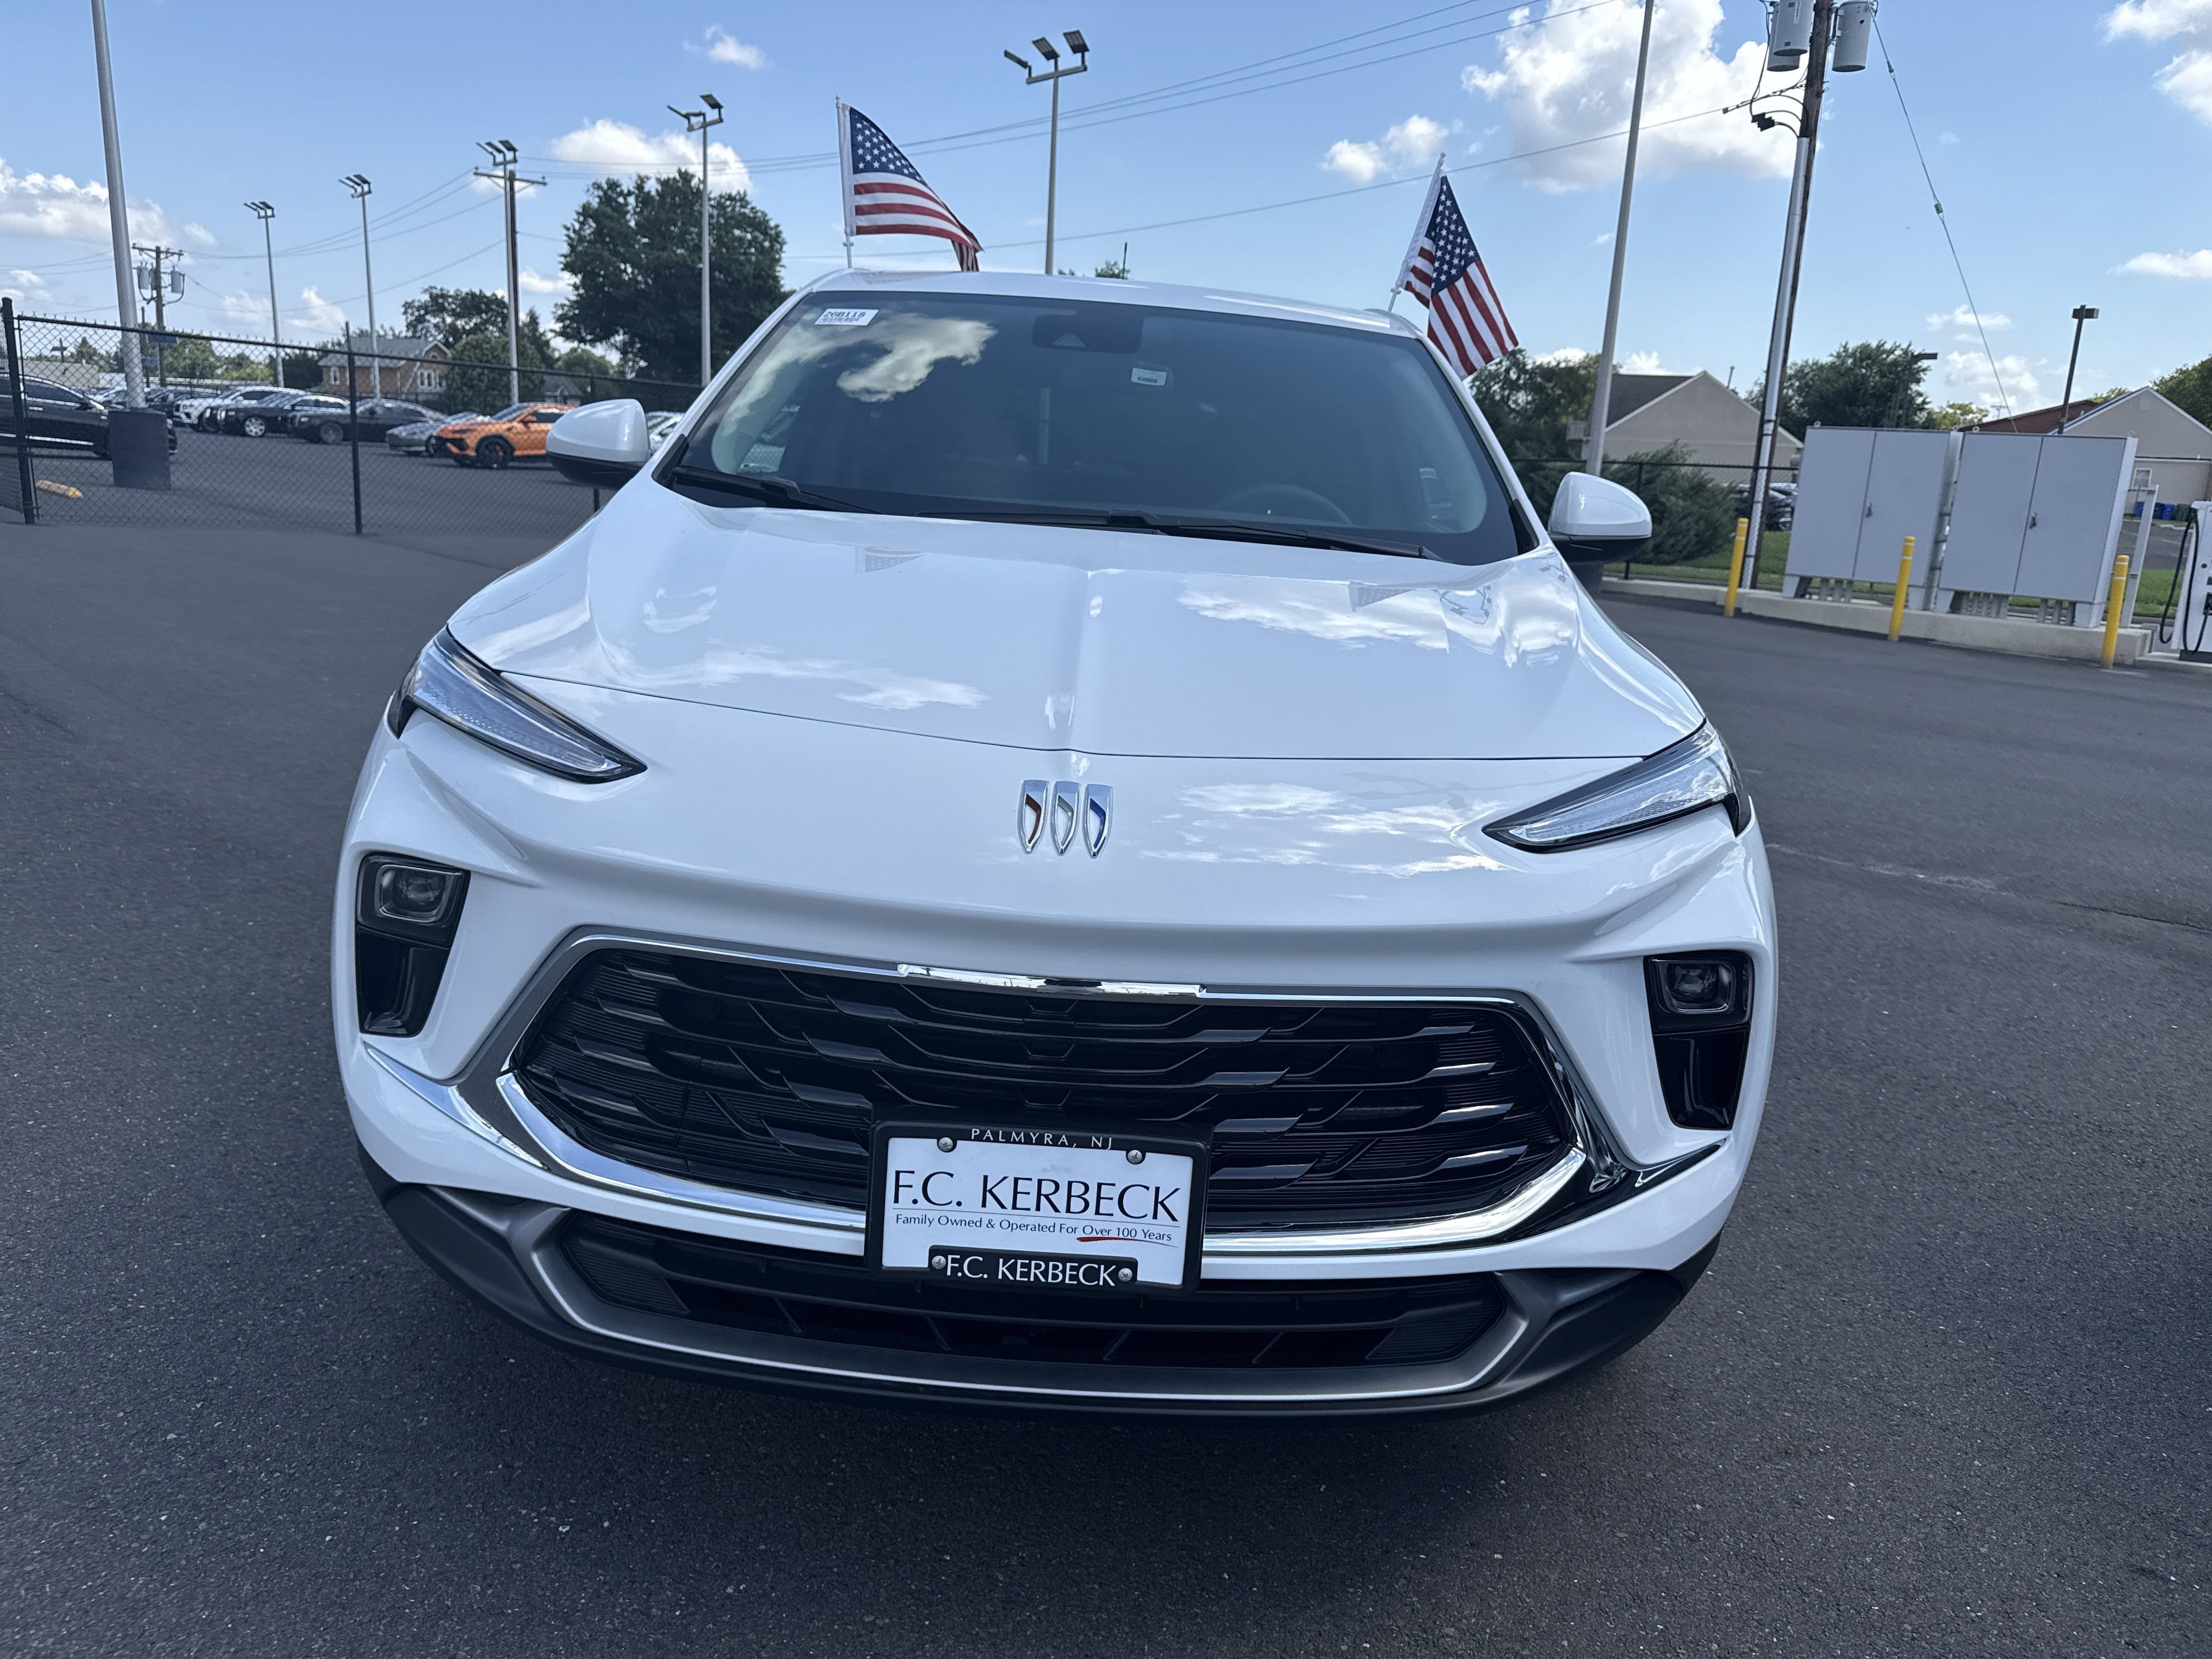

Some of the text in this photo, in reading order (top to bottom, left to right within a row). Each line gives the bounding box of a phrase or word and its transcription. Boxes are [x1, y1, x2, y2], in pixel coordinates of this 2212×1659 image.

[970, 1128, 1113, 1150] PALMYRA, NJ
[893, 1170, 1181, 1222] F.C. KERBECK
[895, 1214, 1172, 1242] Family Owned & Operated For Over 100 Years
[946, 1255, 1116, 1286] F.C. KERBECK
